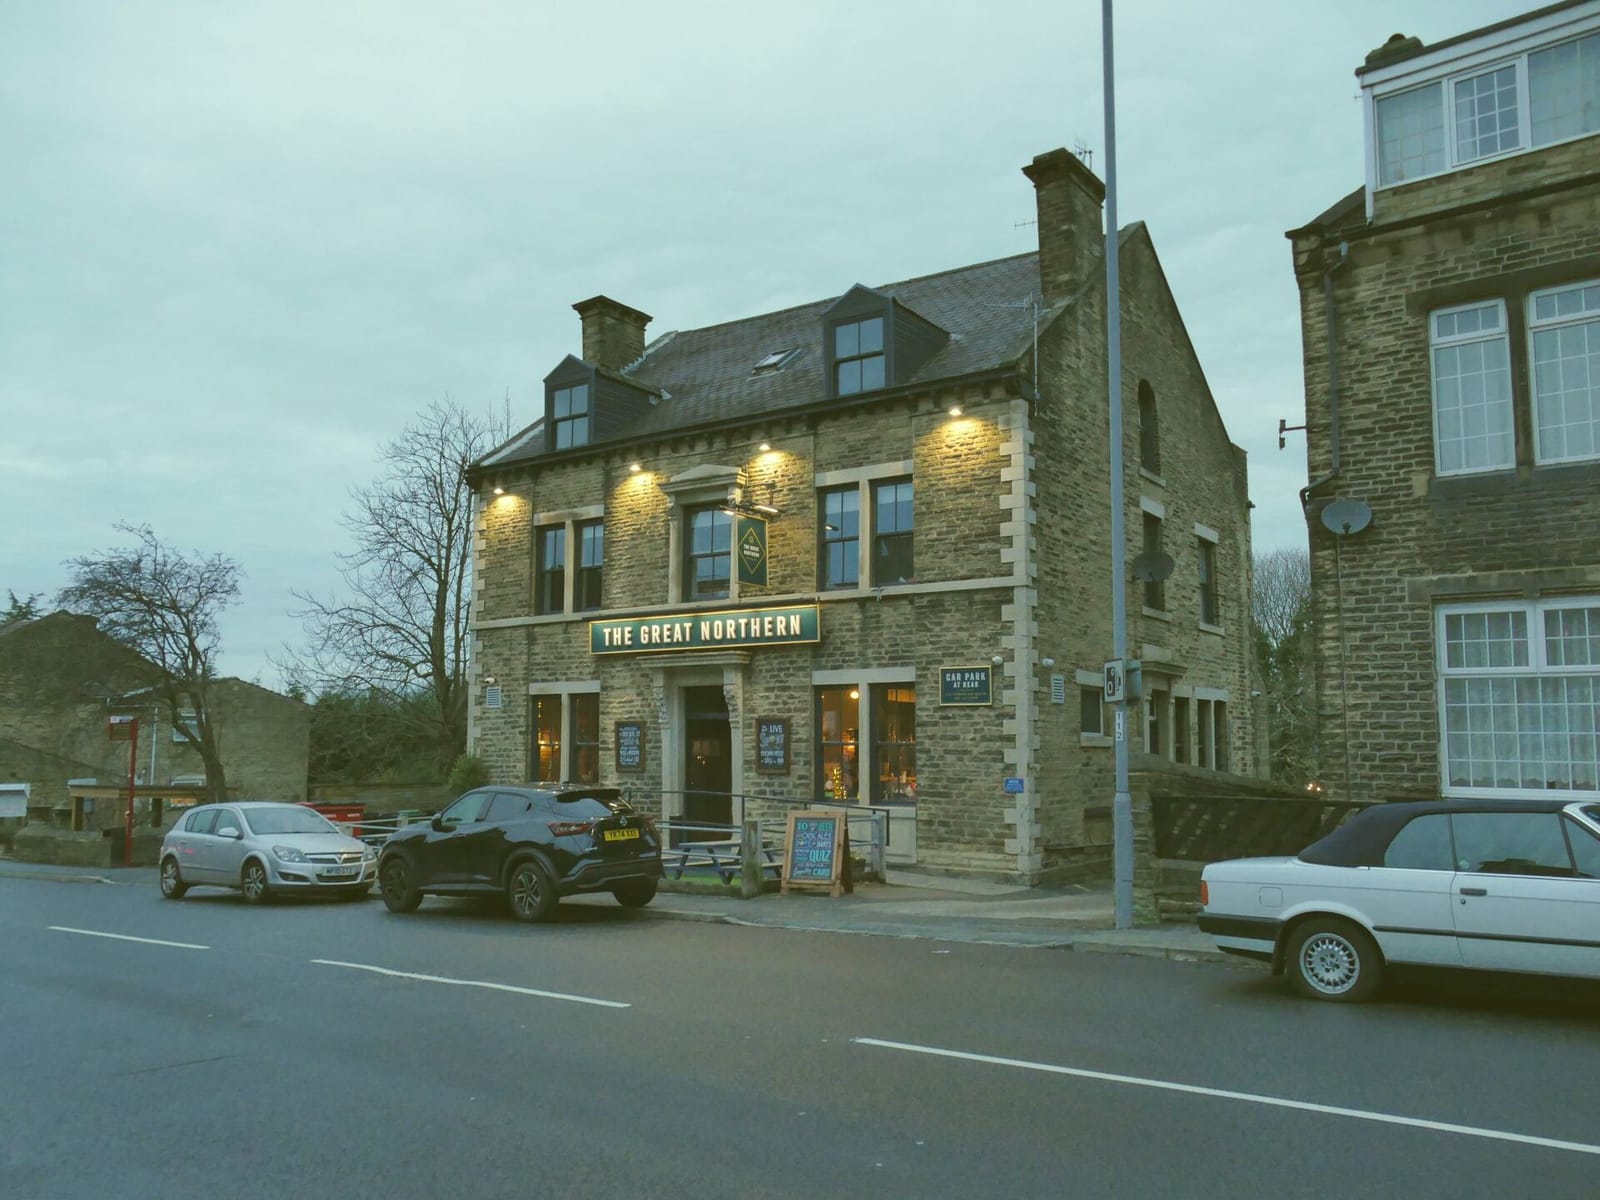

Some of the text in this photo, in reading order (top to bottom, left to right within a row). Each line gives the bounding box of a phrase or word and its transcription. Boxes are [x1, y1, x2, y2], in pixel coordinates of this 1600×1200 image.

[603, 614, 801, 647] THE GREAT NORTHERN
[945, 671, 986, 682] CAR PARK
[769, 724, 783, 733] LIVE
[809, 849, 832, 863] QUIZ
